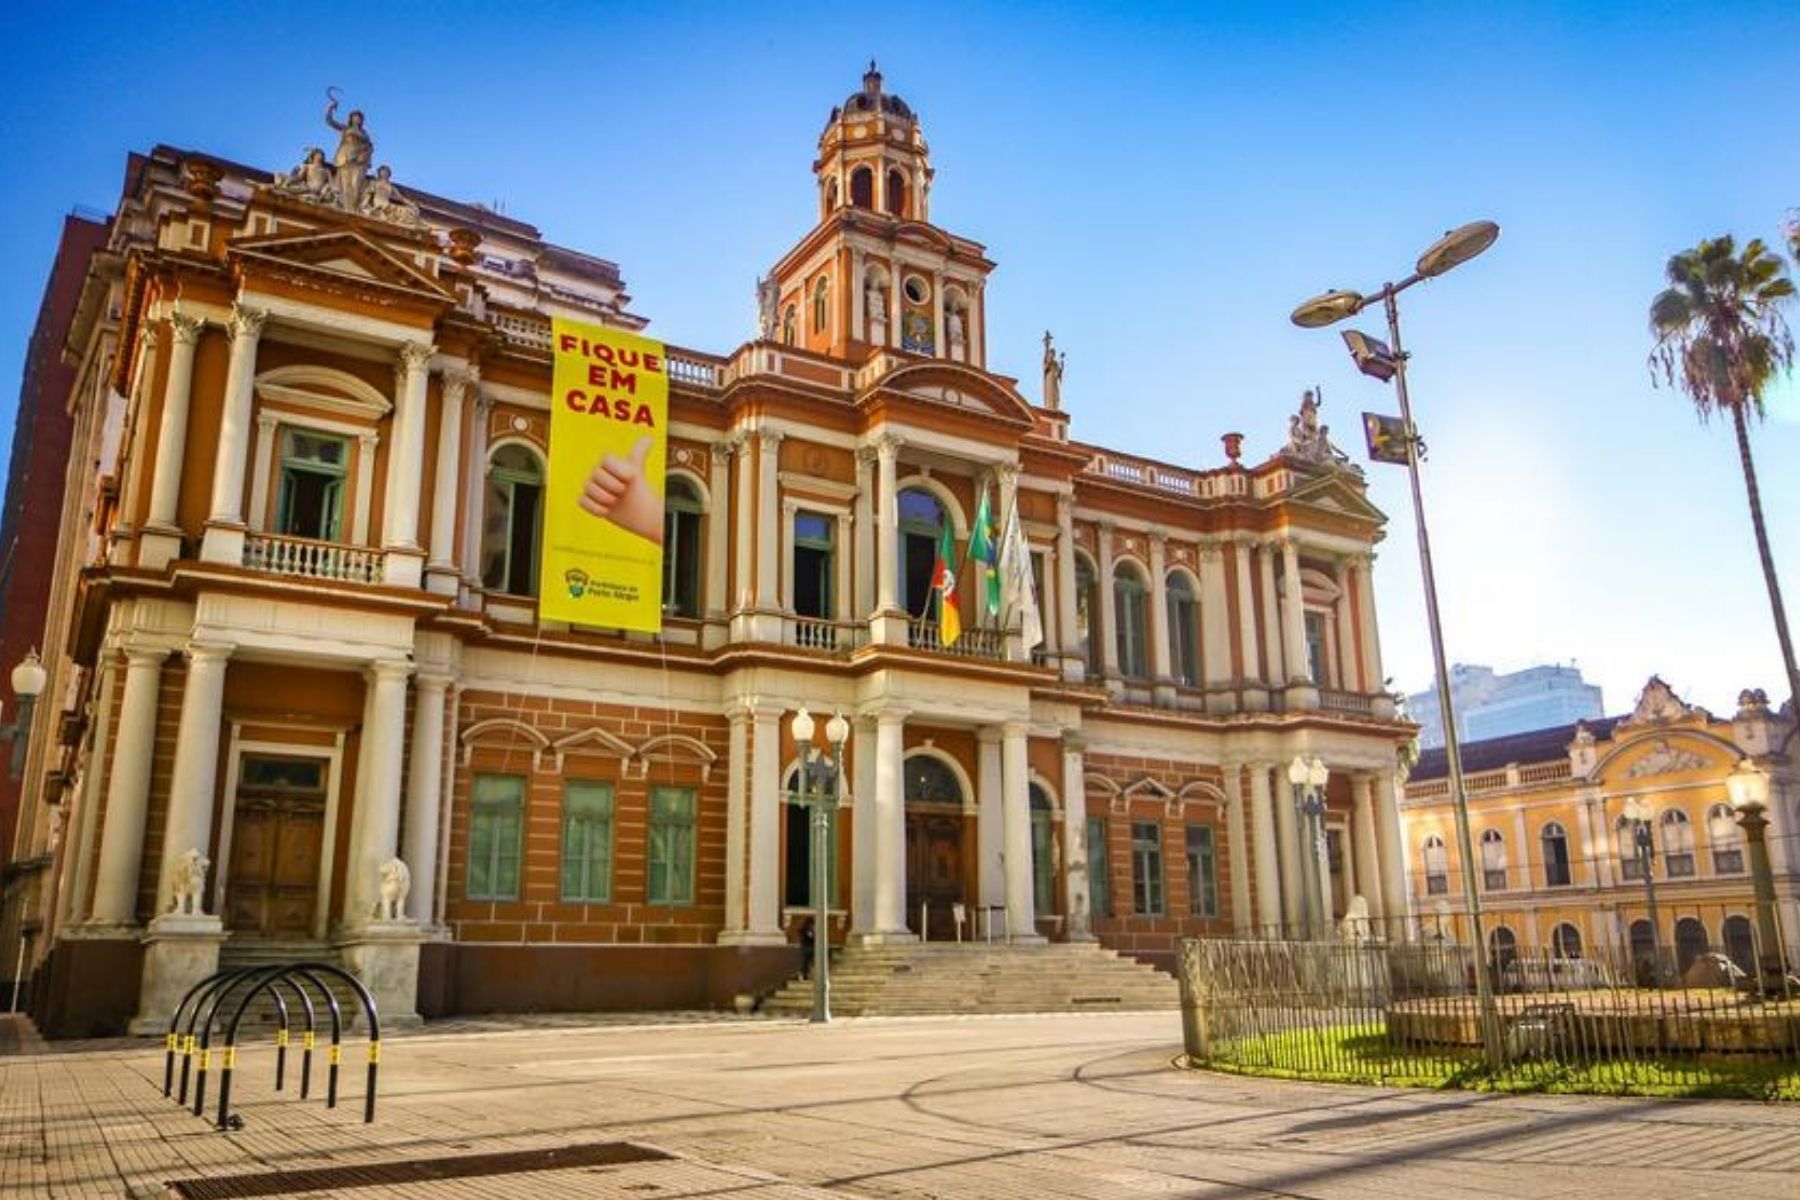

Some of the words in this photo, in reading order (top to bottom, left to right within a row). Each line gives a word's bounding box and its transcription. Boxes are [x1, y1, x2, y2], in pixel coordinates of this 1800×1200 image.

[559, 334, 662, 373] FIQUE
[588, 364, 636, 394] EM
[566, 390, 655, 428] CASA
